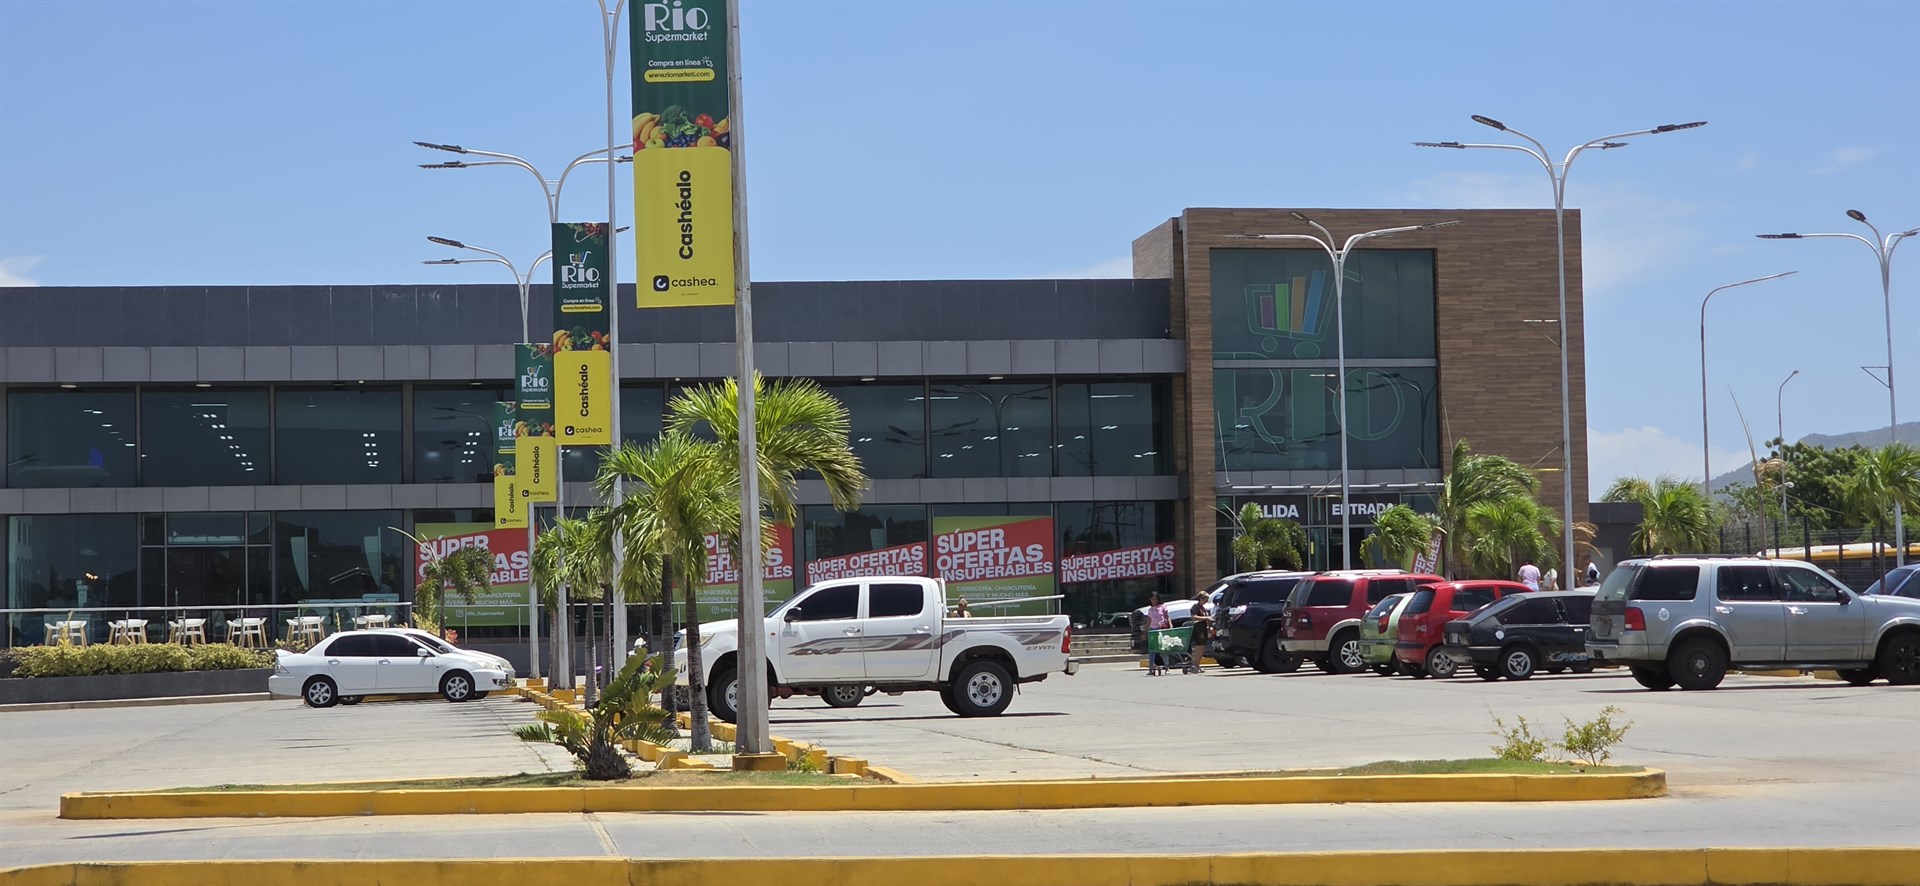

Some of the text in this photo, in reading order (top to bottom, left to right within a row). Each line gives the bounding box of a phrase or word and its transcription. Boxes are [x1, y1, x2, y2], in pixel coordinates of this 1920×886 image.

[644, 0, 709, 31] Rio
[645, 31, 708, 43] Supermarket
[648, 59, 674, 68] Compra
[675, 170, 693, 260] Cashéalo
[561, 263, 600, 282] Rio
[521, 374, 549, 388] Rio
[578, 364, 589, 417] Cashéalo
[532, 445, 540, 484] Cashéalo
[937, 528, 1005, 554] SÚPER
[808, 545, 924, 575] SÚPER OFERTAS
[936, 544, 1044, 571] OFERTAS
[1061, 544, 1175, 571] SÚPER OFERTAS
[940, 561, 1054, 581] INSUPERABLES
[1062, 560, 1174, 583] INSUPERABLES
